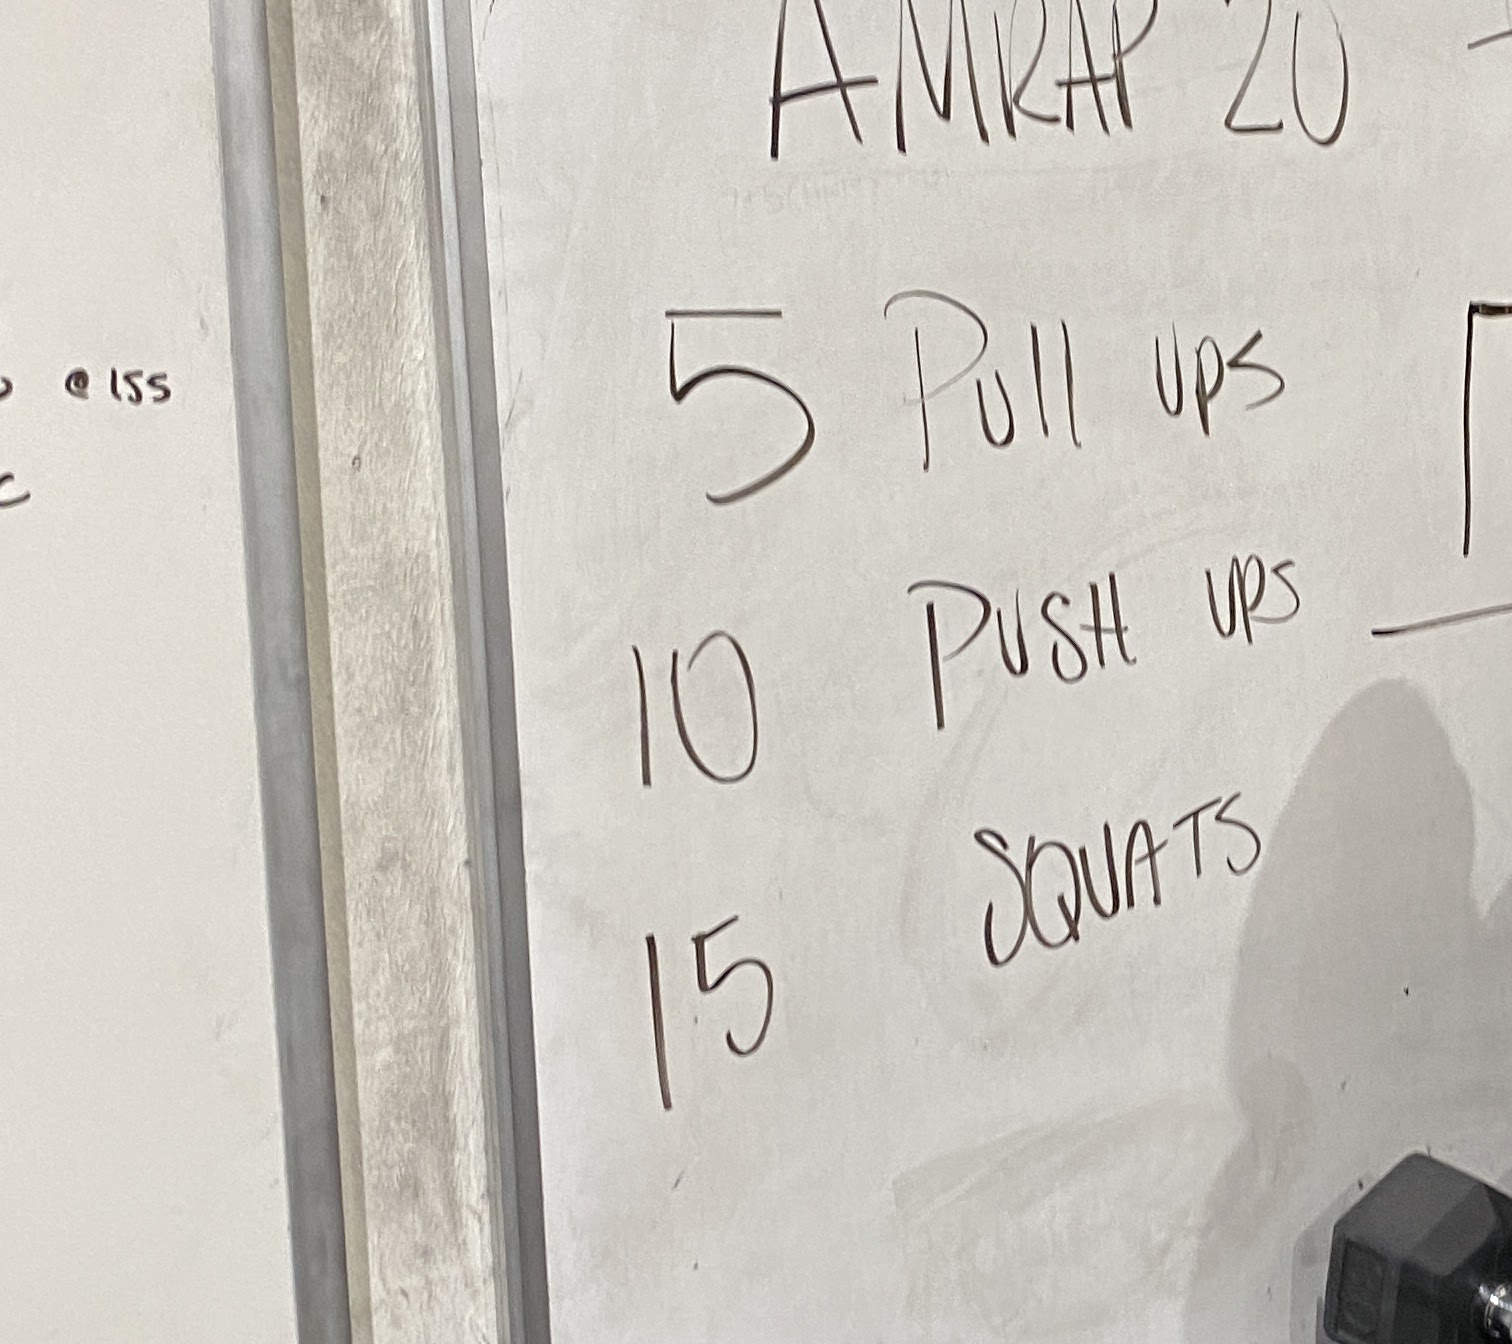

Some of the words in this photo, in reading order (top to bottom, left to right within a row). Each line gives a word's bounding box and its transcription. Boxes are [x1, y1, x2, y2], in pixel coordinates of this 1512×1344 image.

[664, 309, 815, 506] 5
[631, 629, 759, 788] 10
[907, 571, 1138, 731] PUSH
[645, 915, 775, 1112] 15
[973, 792, 1263, 968] SQUATS
